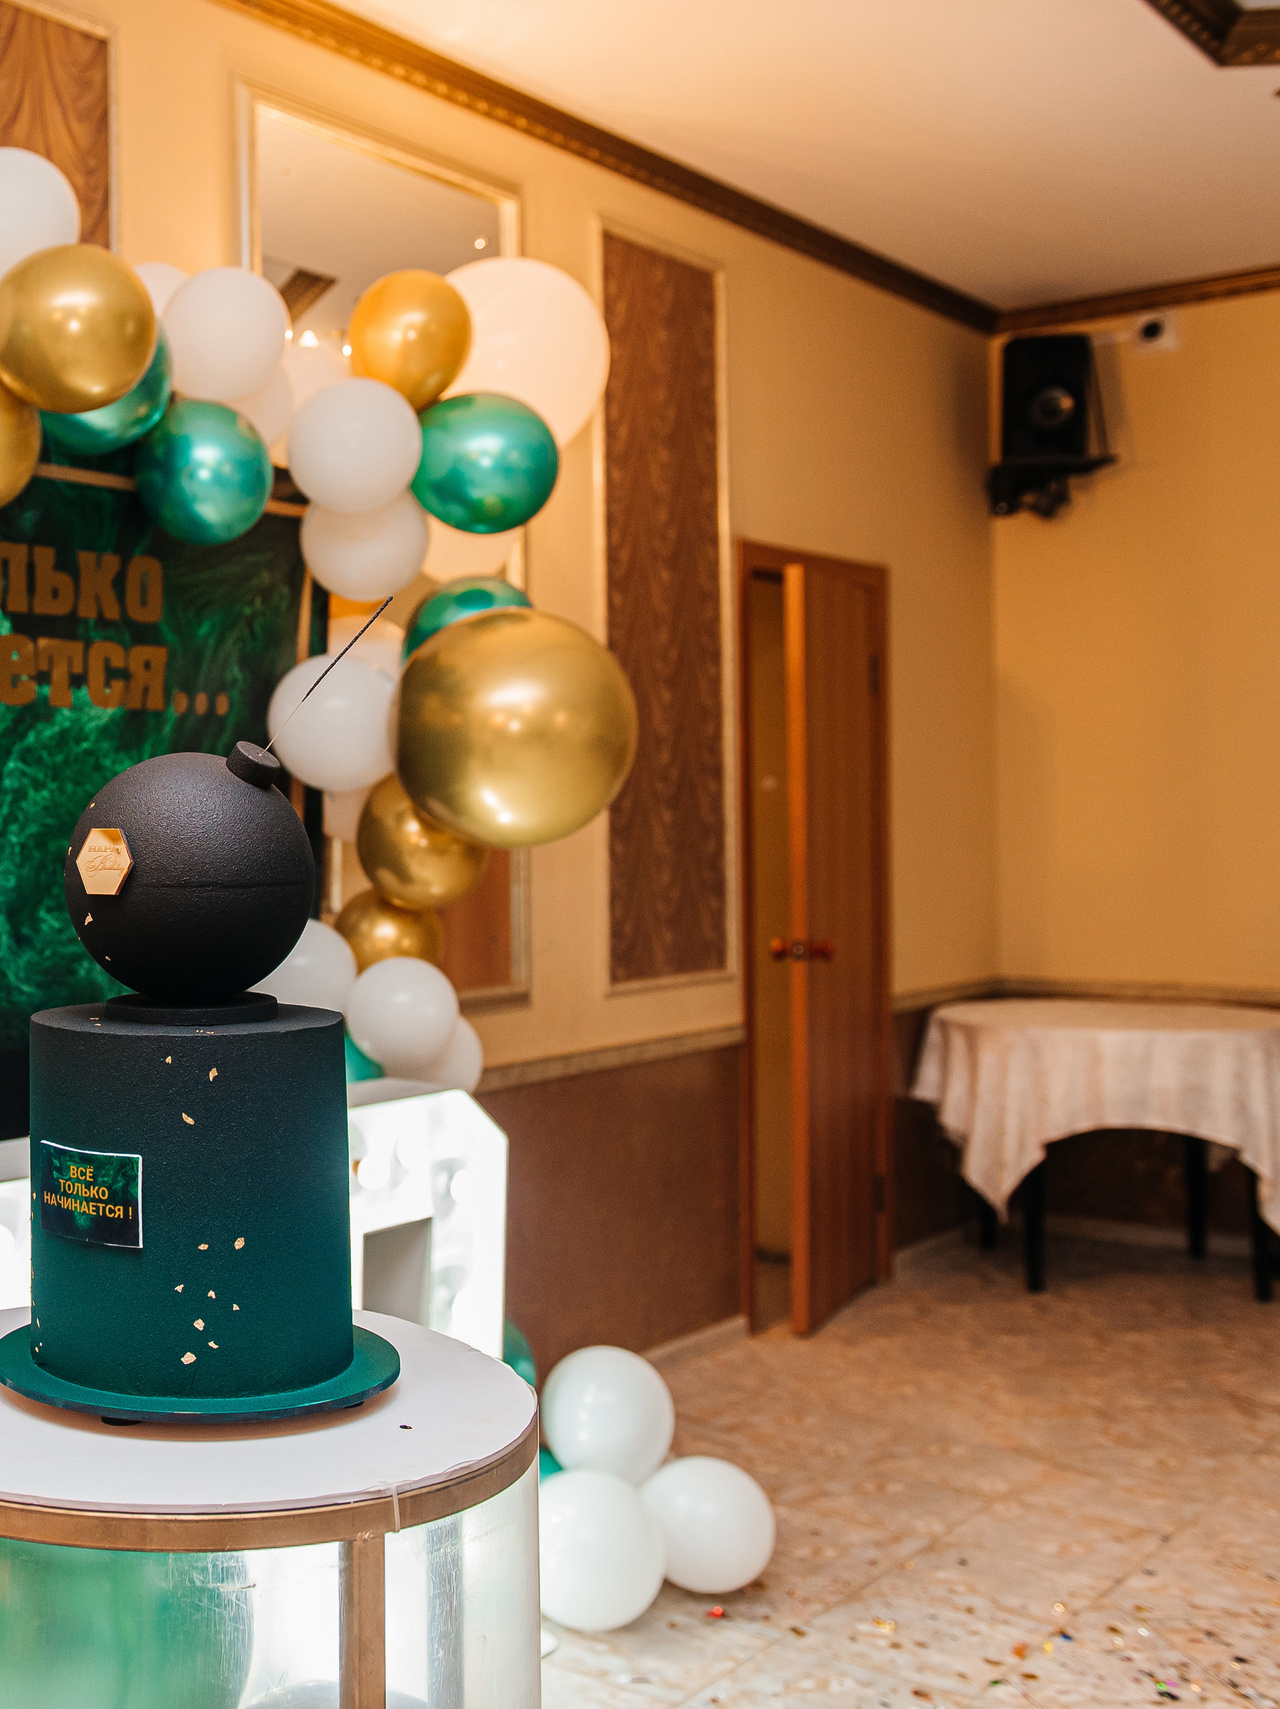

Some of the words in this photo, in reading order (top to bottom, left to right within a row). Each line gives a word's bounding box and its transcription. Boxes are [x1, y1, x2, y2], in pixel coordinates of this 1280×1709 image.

[70, 1165, 94, 1181] ВСЁ
[59, 1179, 109, 1200] ТОЛЬКО
[43, 1191, 124, 1218] НАЧИНАЕТСЯ
[128, 1206, 133, 1220] !
